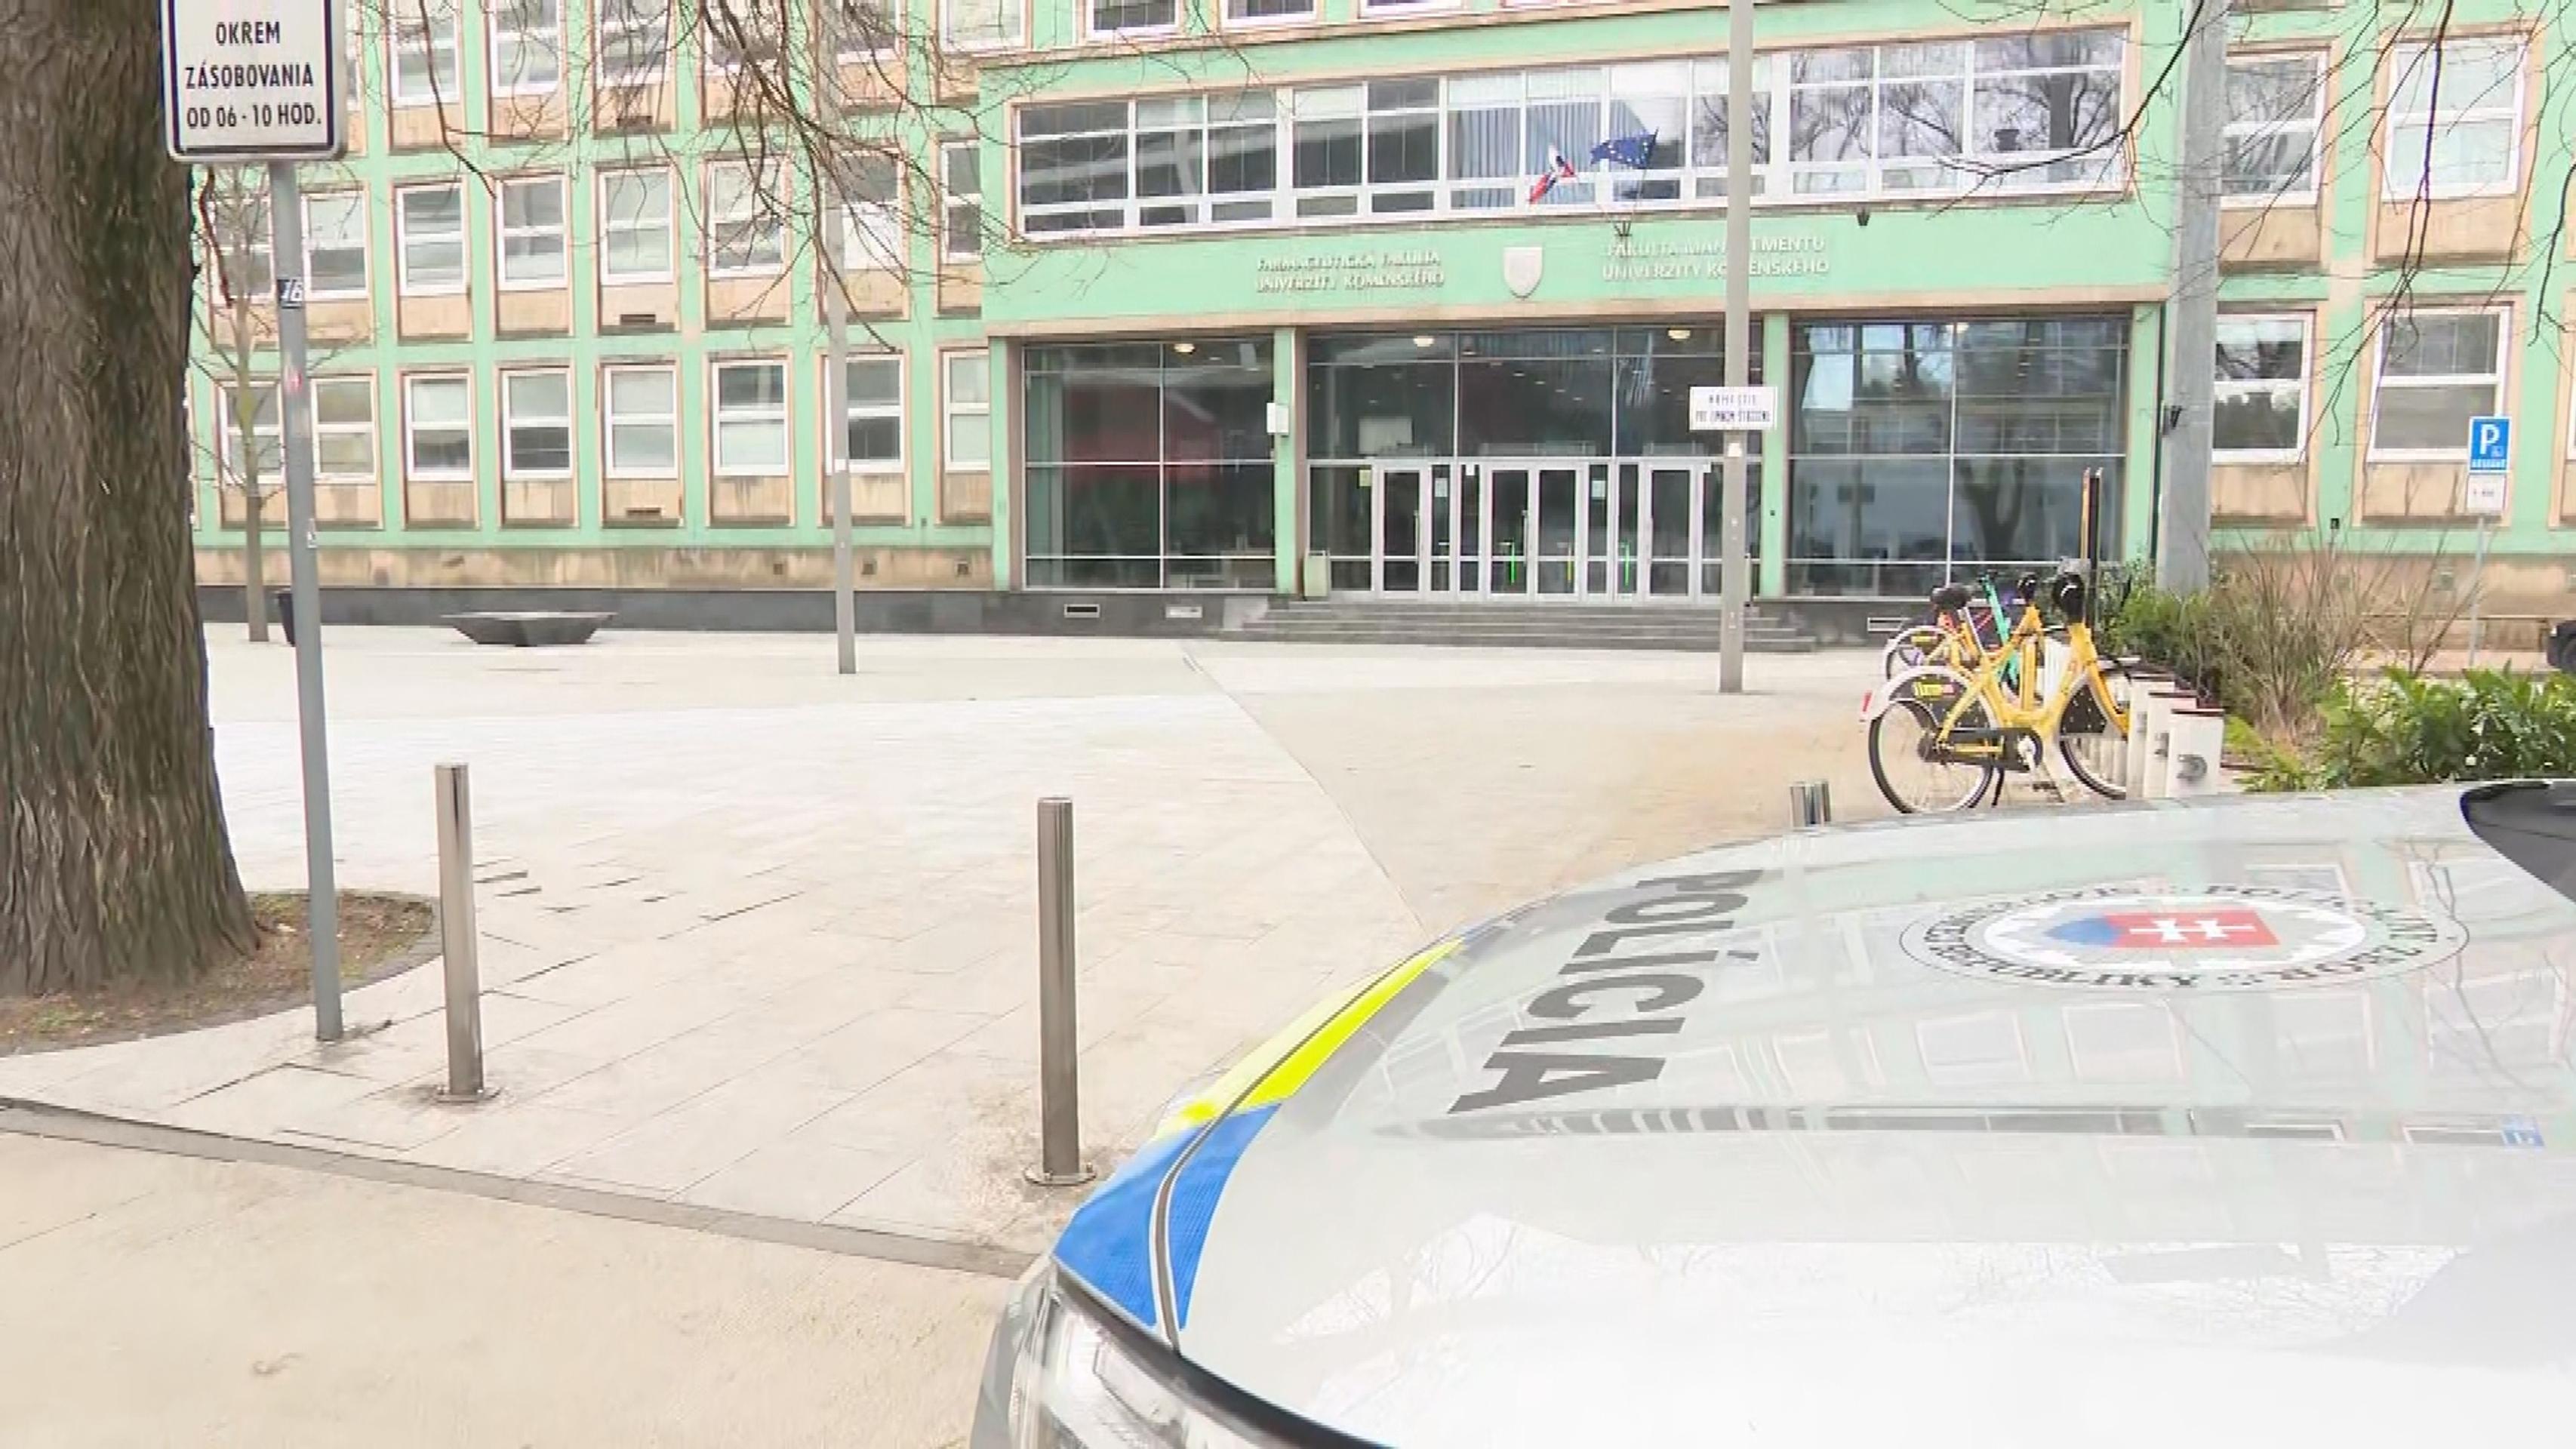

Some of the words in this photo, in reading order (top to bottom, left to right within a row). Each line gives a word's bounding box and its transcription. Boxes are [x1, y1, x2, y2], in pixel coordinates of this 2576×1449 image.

[216, 21, 281, 45] OKREM
[185, 60, 314, 89] ZÁSOBOVANIA
[186, 106, 211, 129] OD
[216, 105, 237, 128] 06
[252, 103, 272, 127] 10
[277, 102, 322, 125] HOD.
[2479, 423, 2500, 454] P
[1448, 869, 1765, 1115] POLÍCIA
